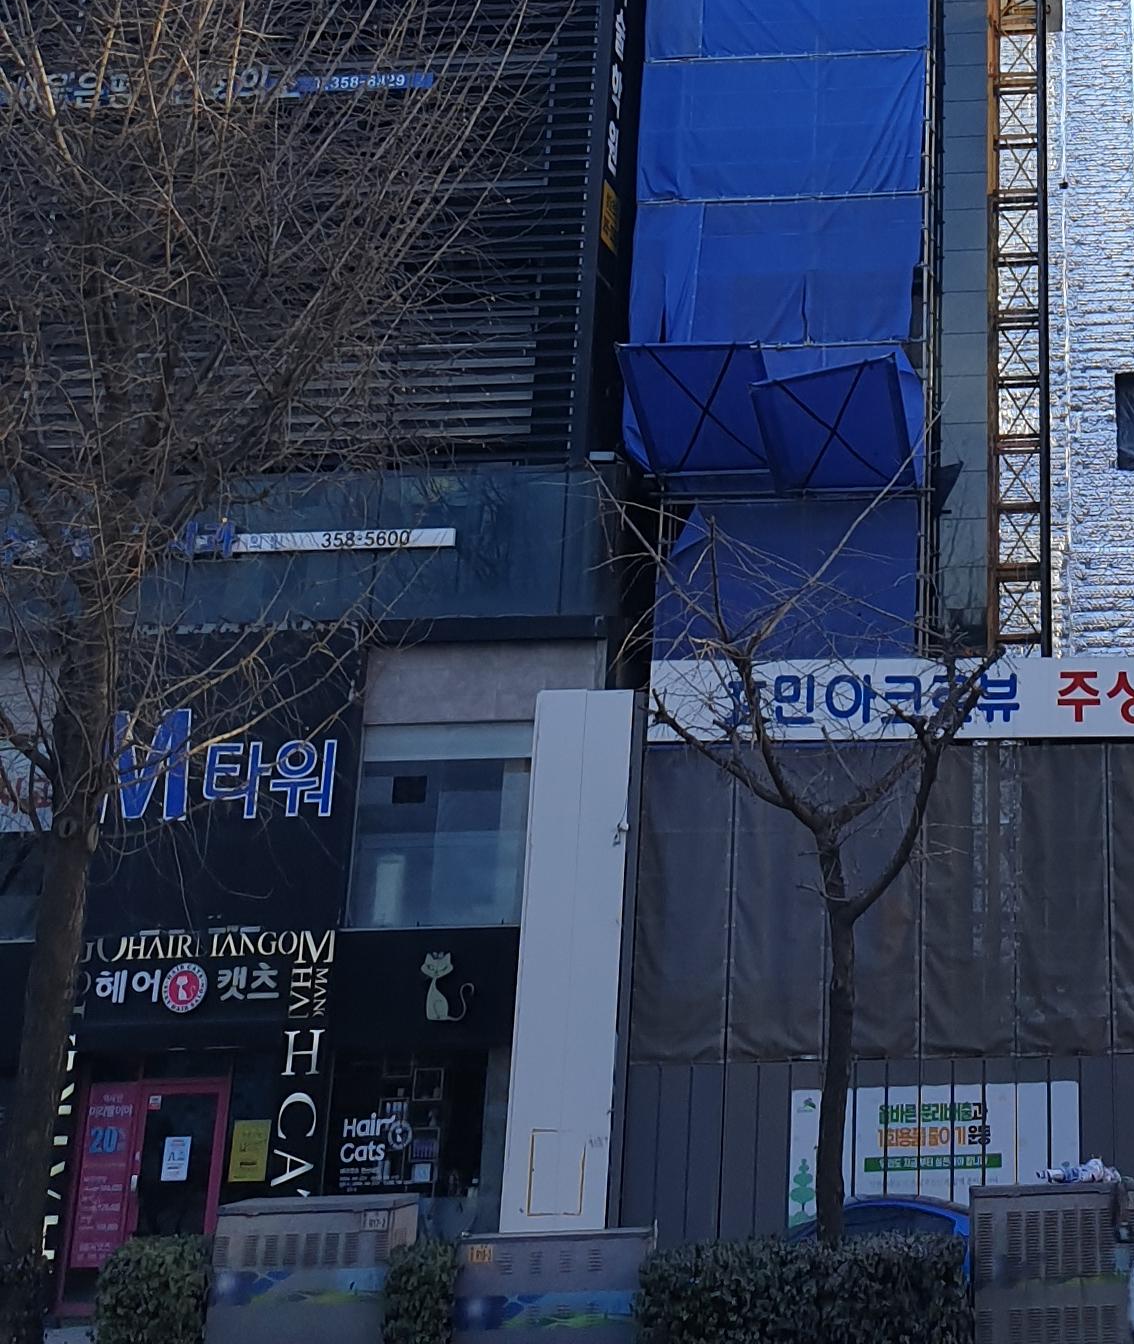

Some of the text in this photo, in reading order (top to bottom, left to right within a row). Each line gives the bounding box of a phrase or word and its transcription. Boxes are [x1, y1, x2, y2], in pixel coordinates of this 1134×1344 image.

[96, 969, 162, 1004] 헤어
[216, 962, 280, 1001] 캣츠
[343, 1112, 397, 1137] Hair
[340, 1140, 386, 1163] Cats
